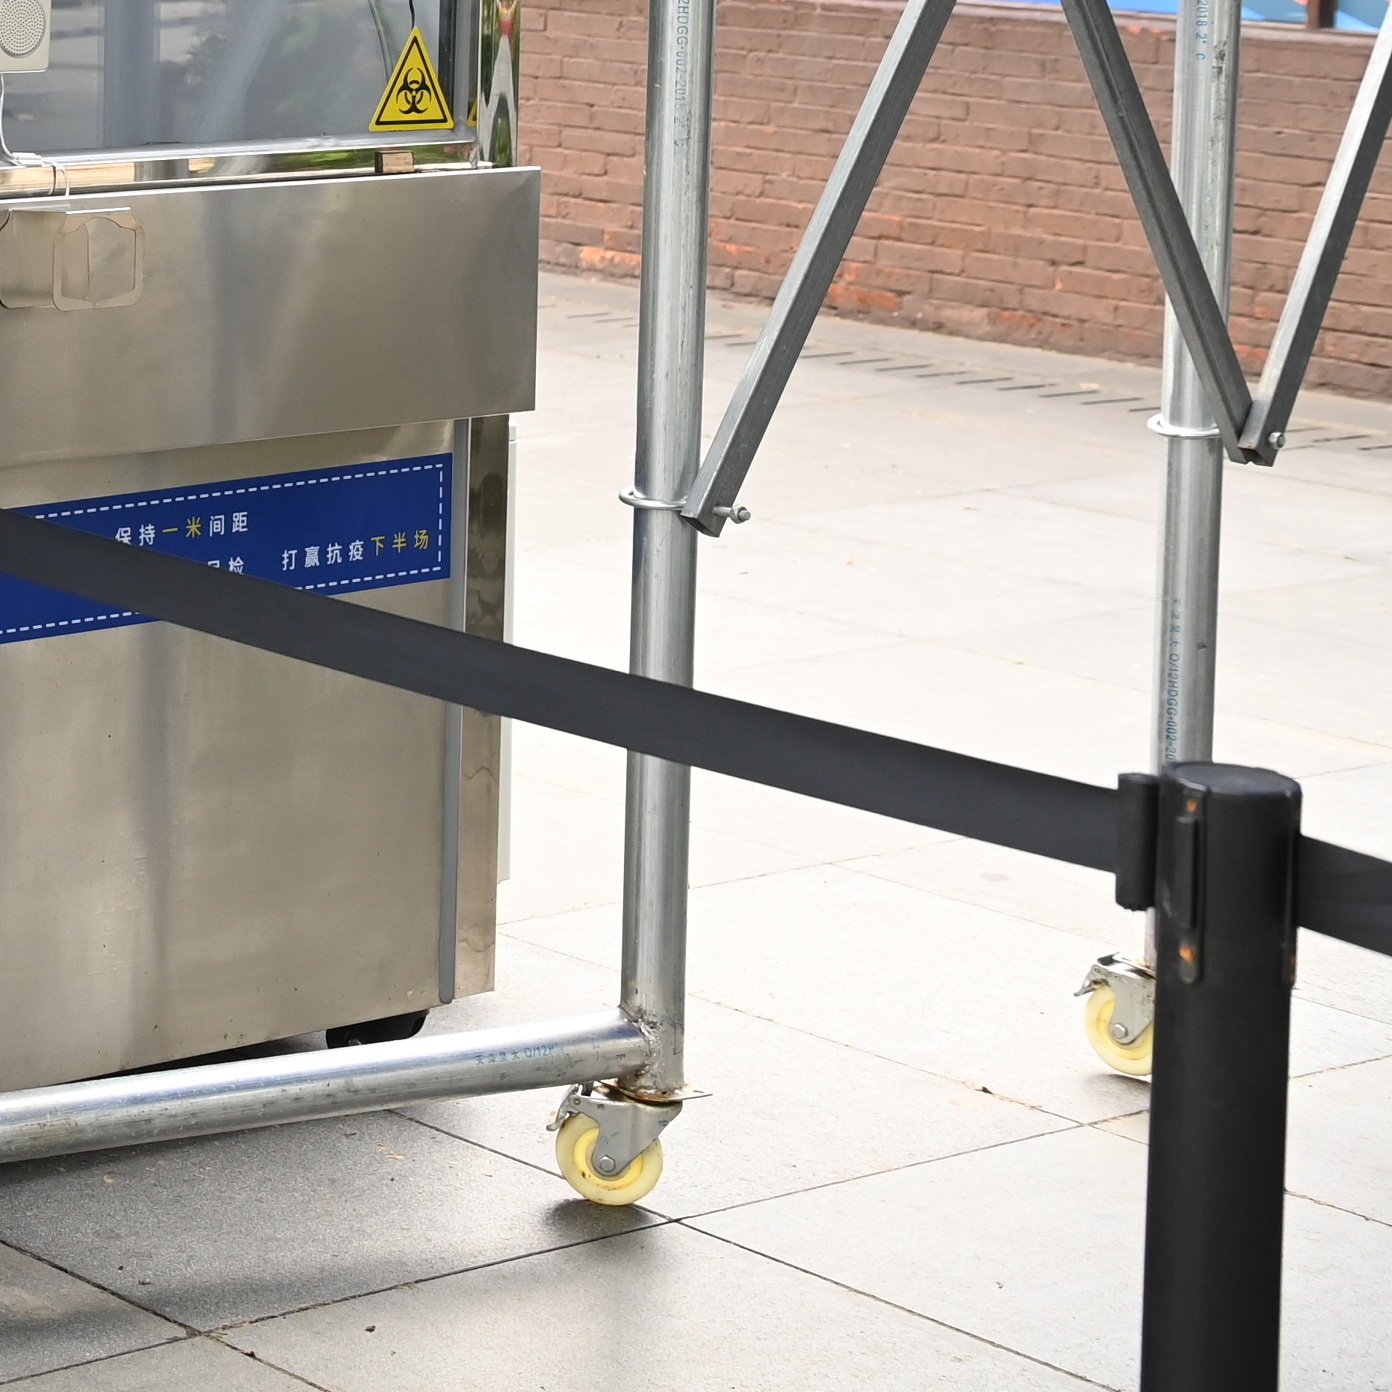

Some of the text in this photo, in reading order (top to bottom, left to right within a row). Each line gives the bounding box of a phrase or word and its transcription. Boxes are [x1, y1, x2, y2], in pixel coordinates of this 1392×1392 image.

[115, 511, 249, 546] 保持一米间距
[282, 529, 431, 573] 打赢抗疫下半场
